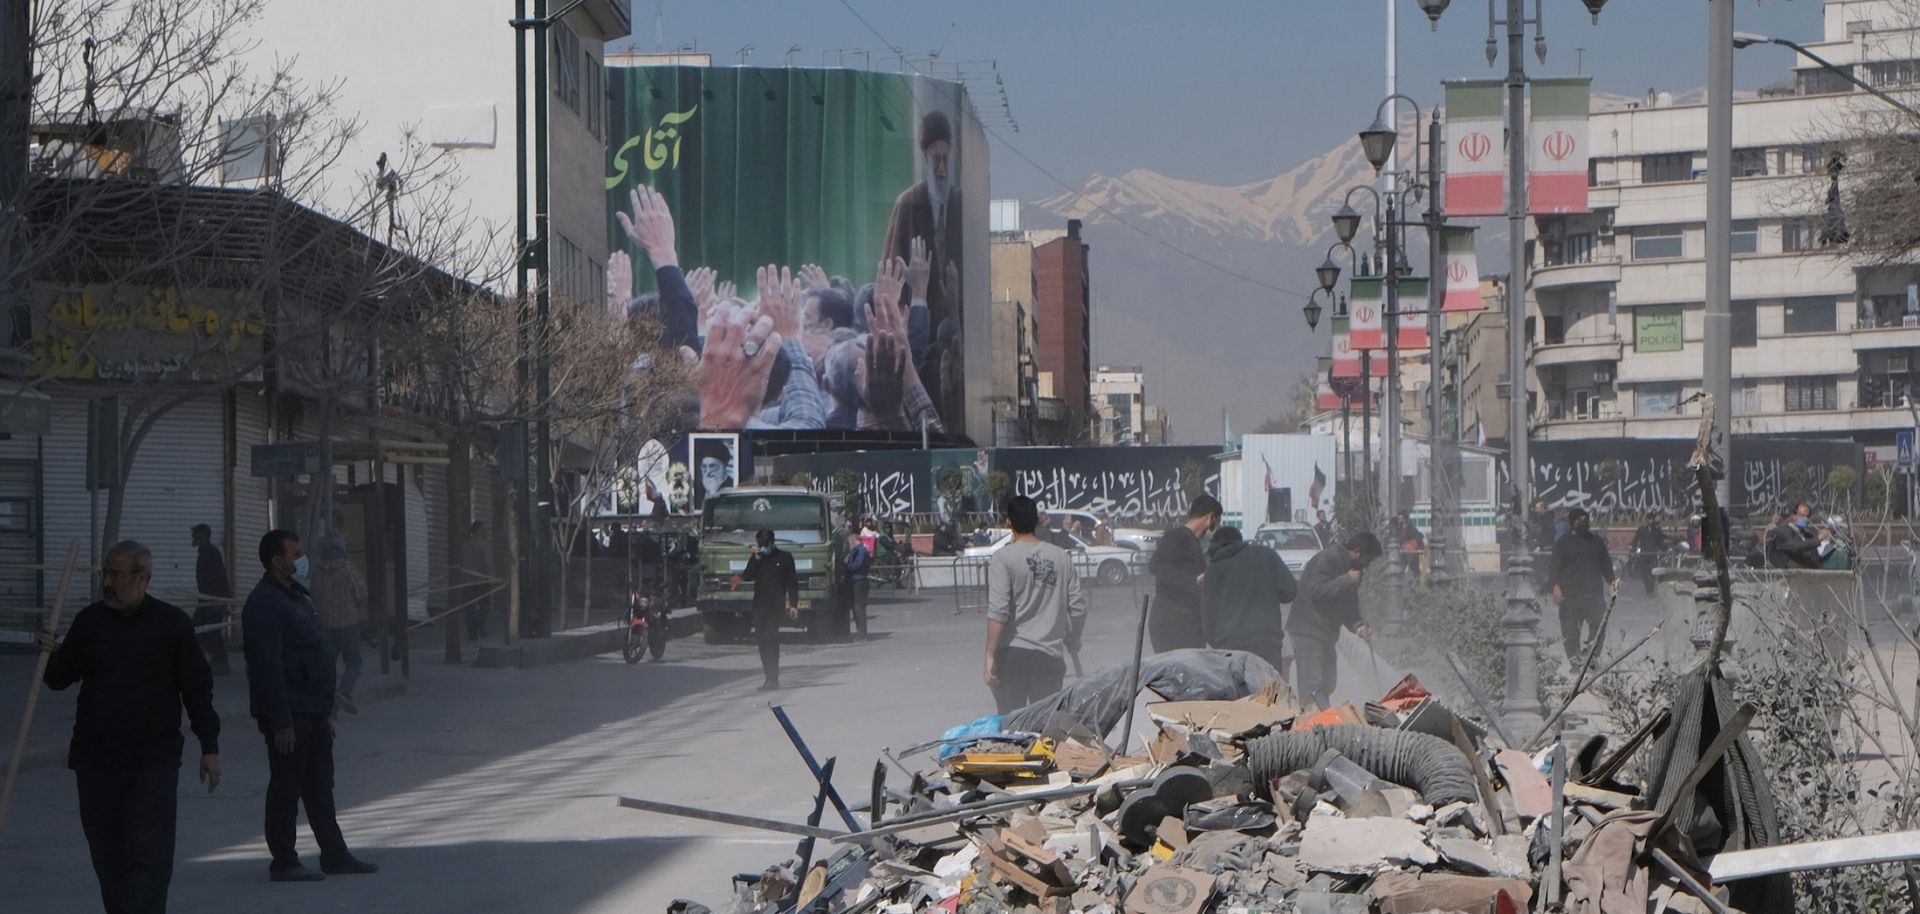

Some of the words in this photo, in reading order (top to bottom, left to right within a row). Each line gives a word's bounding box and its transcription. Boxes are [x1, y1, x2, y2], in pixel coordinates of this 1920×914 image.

[606, 104, 697, 189] آقای
[1641, 317, 1678, 330] پلیس
[1640, 335, 1680, 345] POLICE
